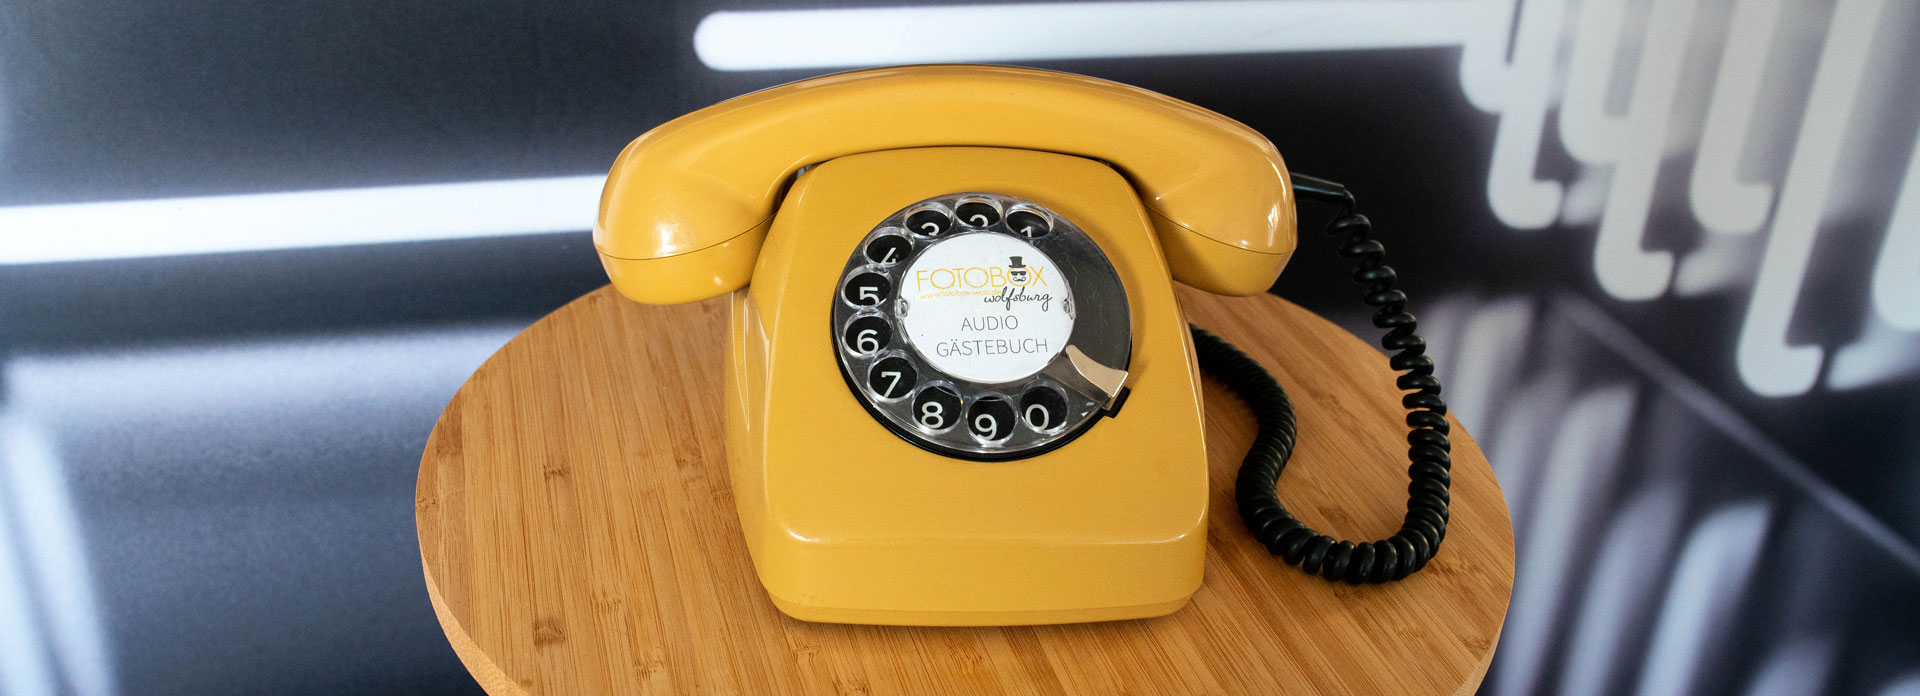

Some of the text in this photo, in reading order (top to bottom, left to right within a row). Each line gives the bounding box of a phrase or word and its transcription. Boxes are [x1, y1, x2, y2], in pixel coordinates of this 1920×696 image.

[916, 265, 1048, 291] FOTOBOX
[859, 286, 880, 306] 5
[983, 286, 1053, 312] wolfsburg
[961, 315, 1018, 332] AUDIO
[856, 328, 879, 354] 6
[936, 338, 1048, 357] GÄSTEBUCH
[881, 371, 901, 398] 7
[921, 401, 944, 429] 8
[974, 413, 997, 441] 9
